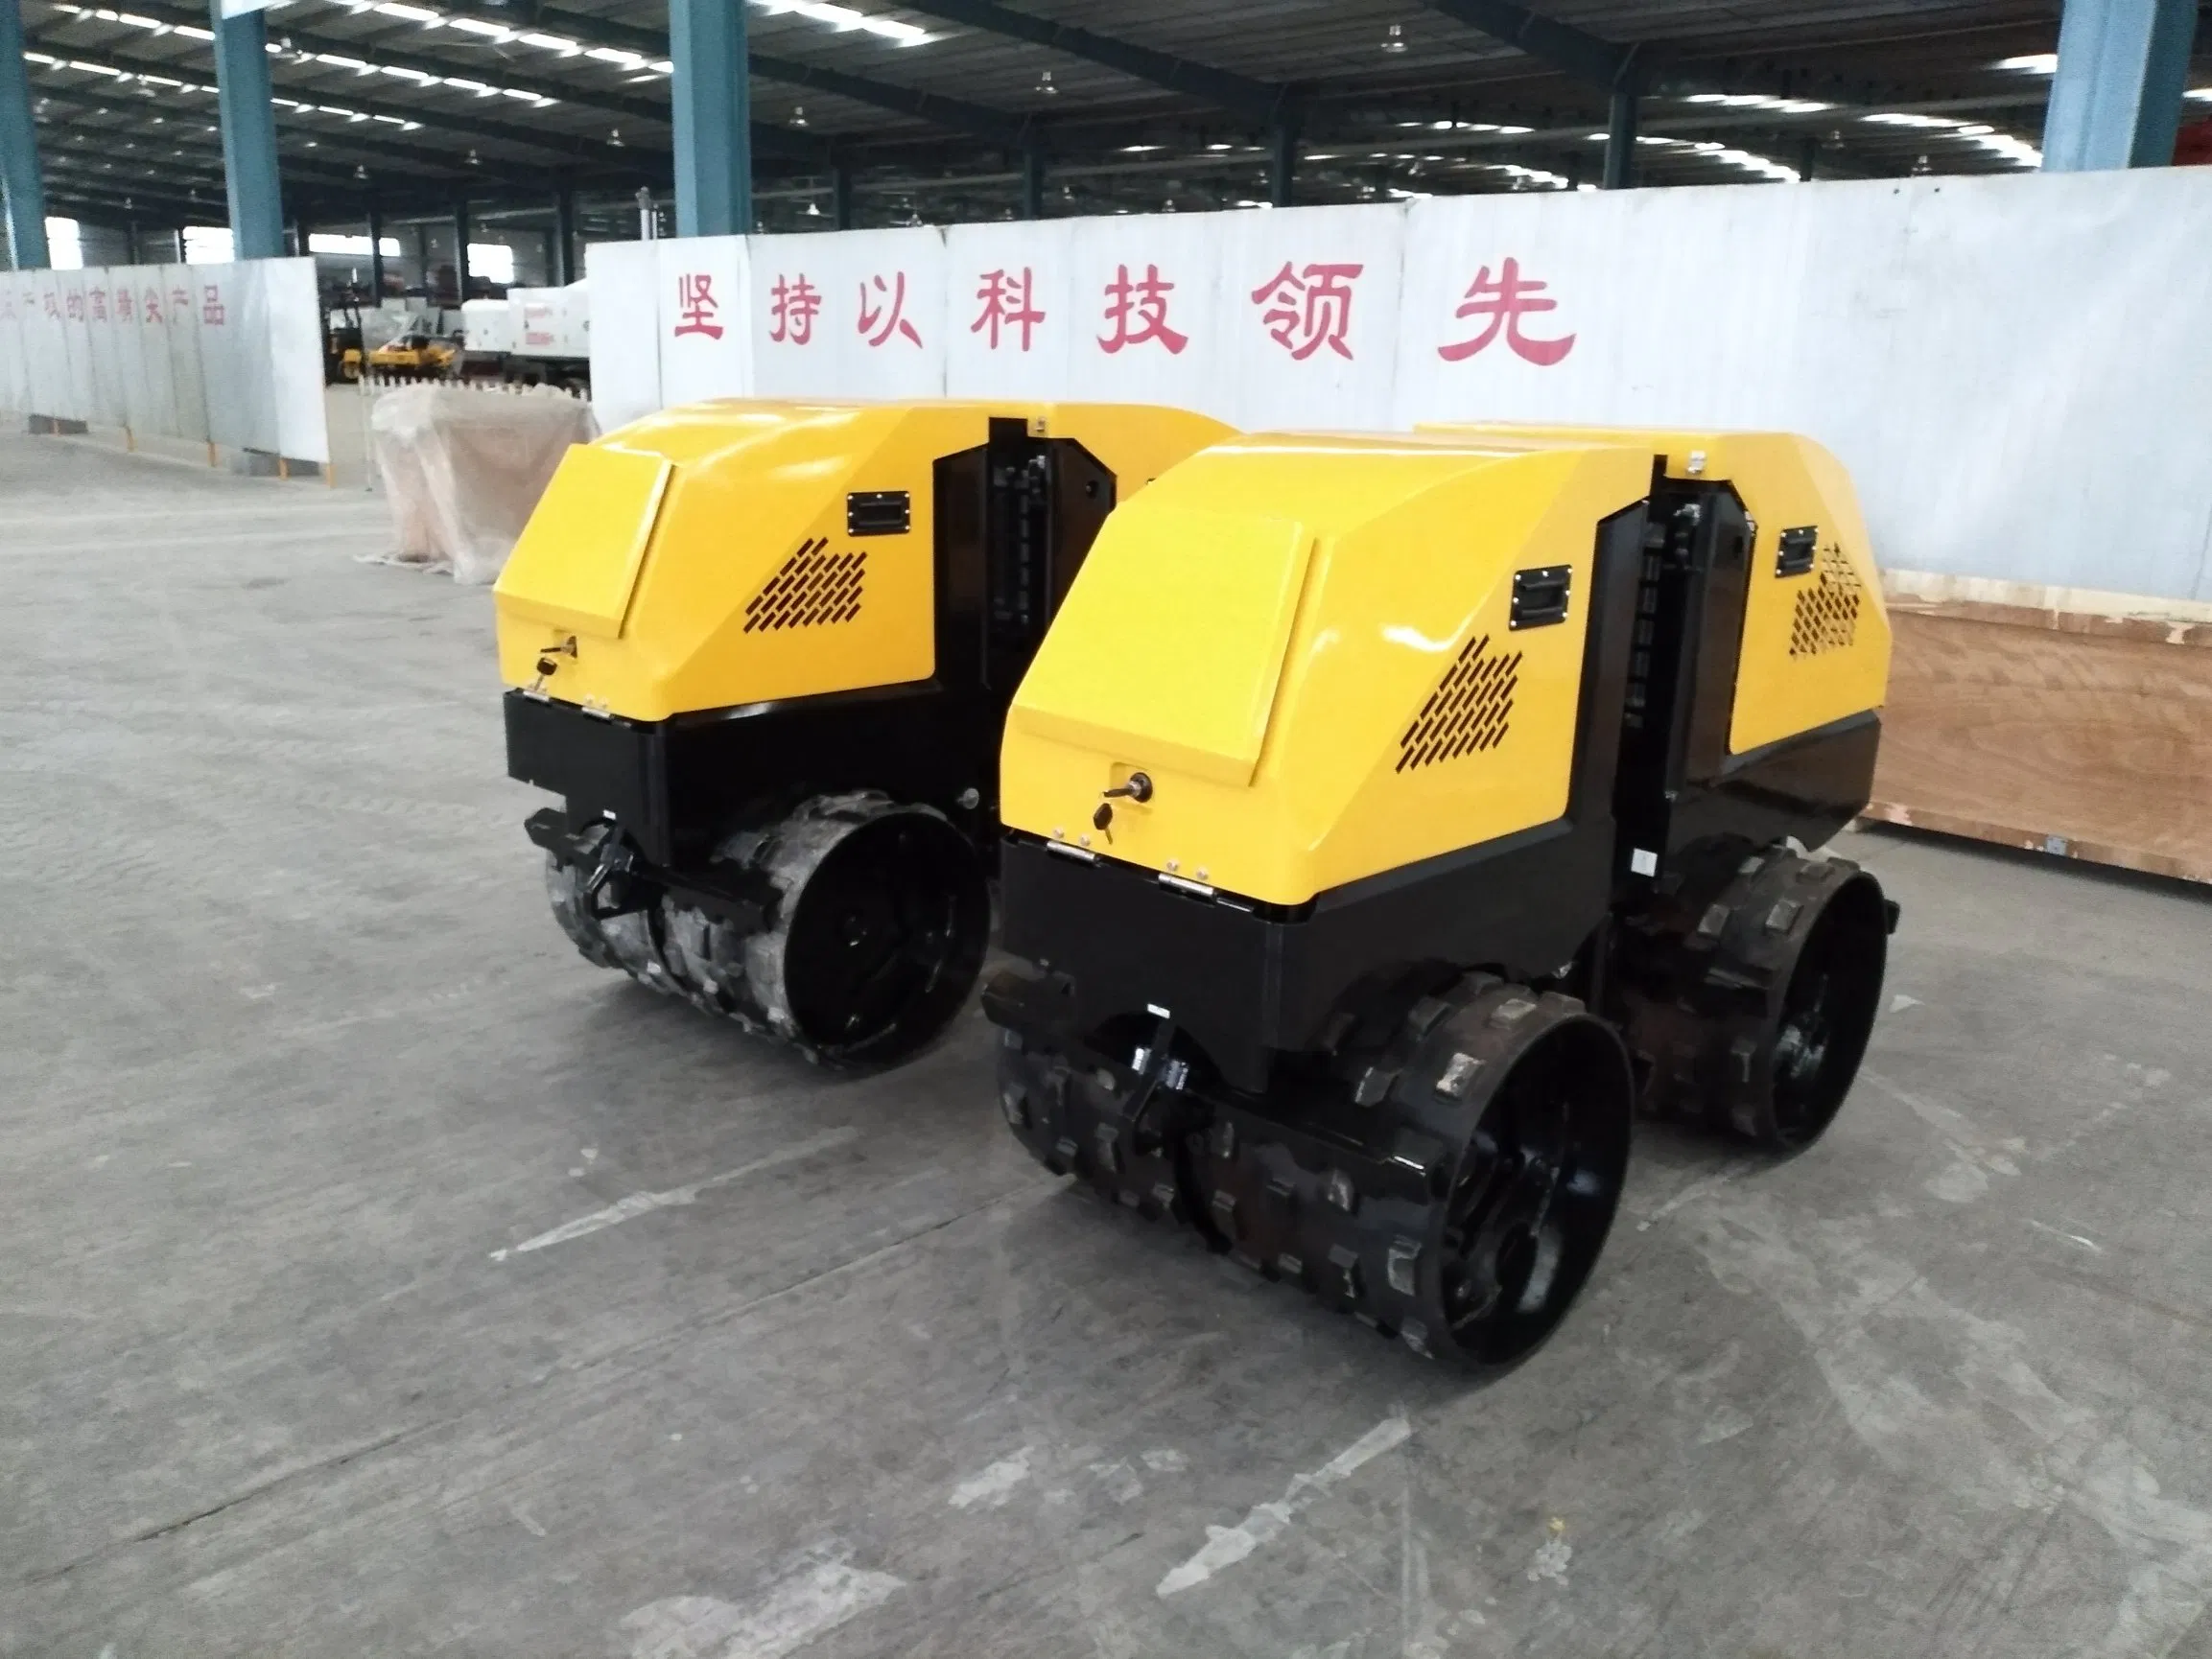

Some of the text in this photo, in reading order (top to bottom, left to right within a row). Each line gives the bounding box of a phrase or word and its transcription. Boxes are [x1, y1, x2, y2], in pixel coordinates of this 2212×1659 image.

[674, 257, 1575, 366] 坚持以科技领先
